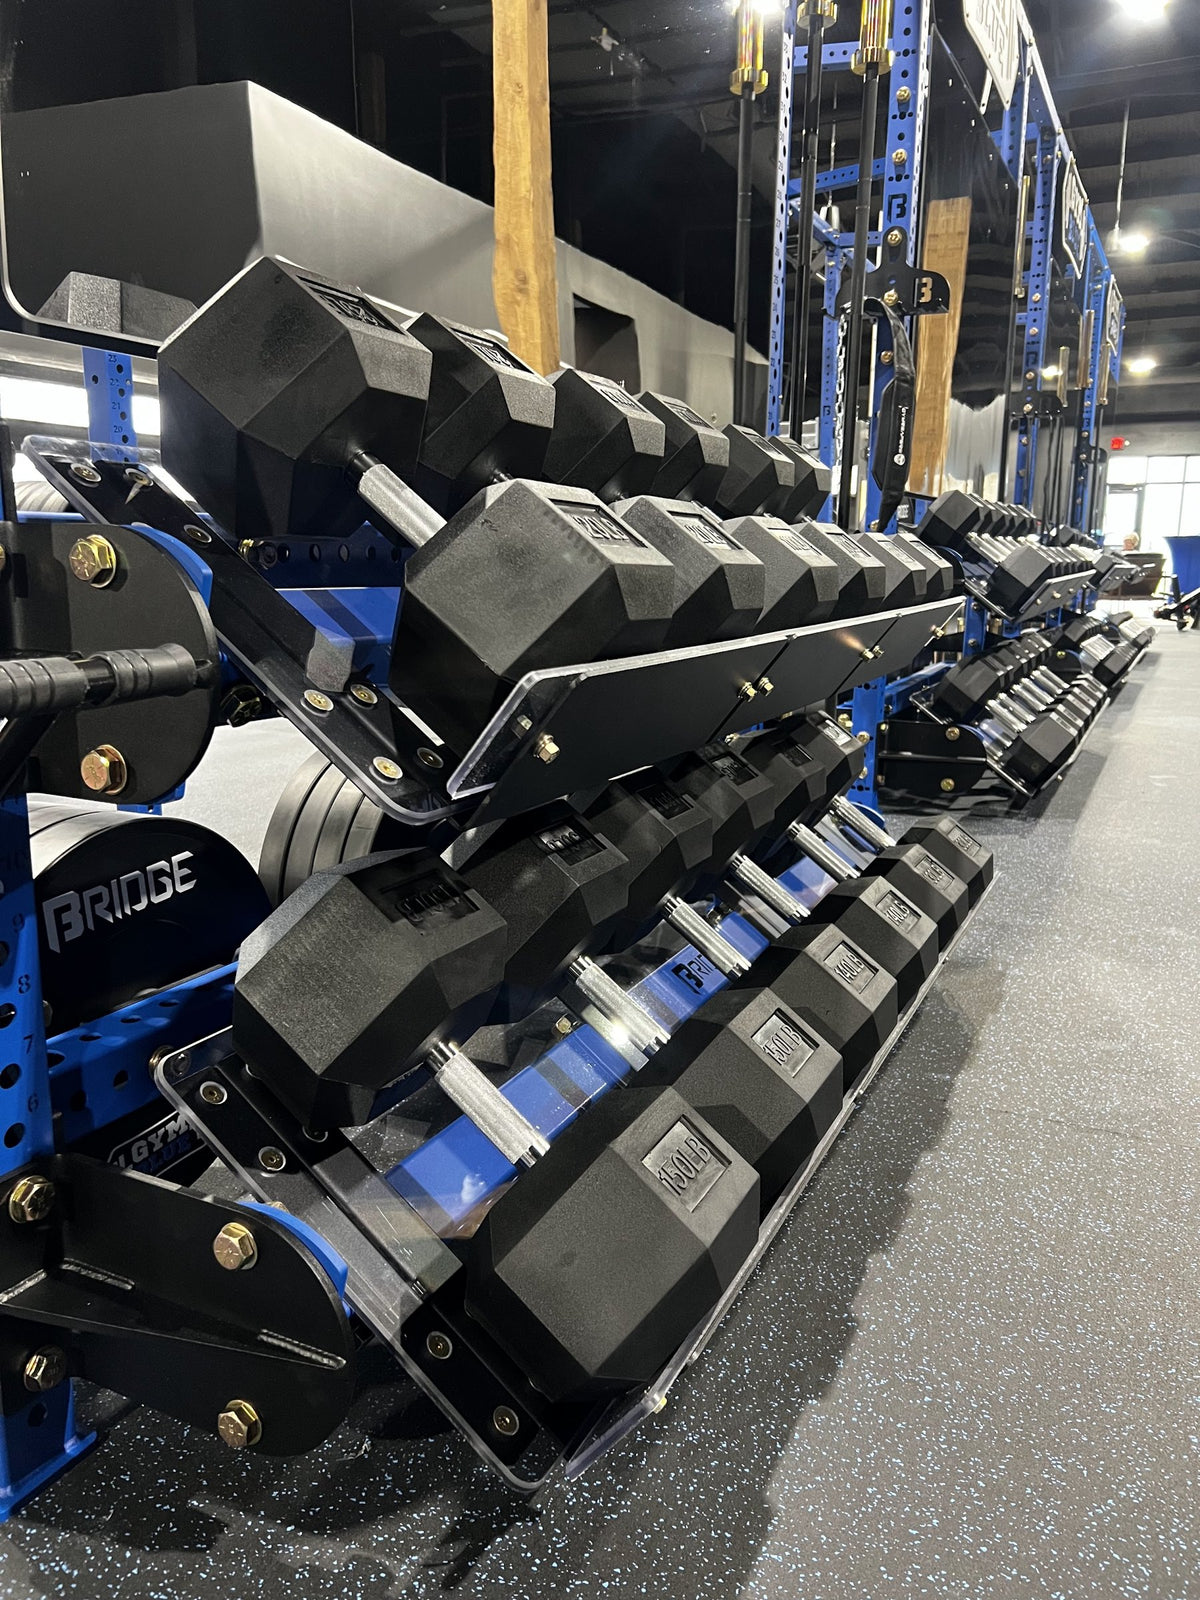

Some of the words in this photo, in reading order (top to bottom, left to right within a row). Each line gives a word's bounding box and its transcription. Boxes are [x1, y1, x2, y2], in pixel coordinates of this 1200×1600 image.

[42, 850, 197, 954] BRIDGE
[18, 973, 31, 995] 8
[833, 953, 866, 985] 140LB
[23, 1033, 34, 1055] 7
[762, 1025, 803, 1067] 150LB
[27, 1092, 39, 1113] 6
[658, 1135, 712, 1197] 150LB
